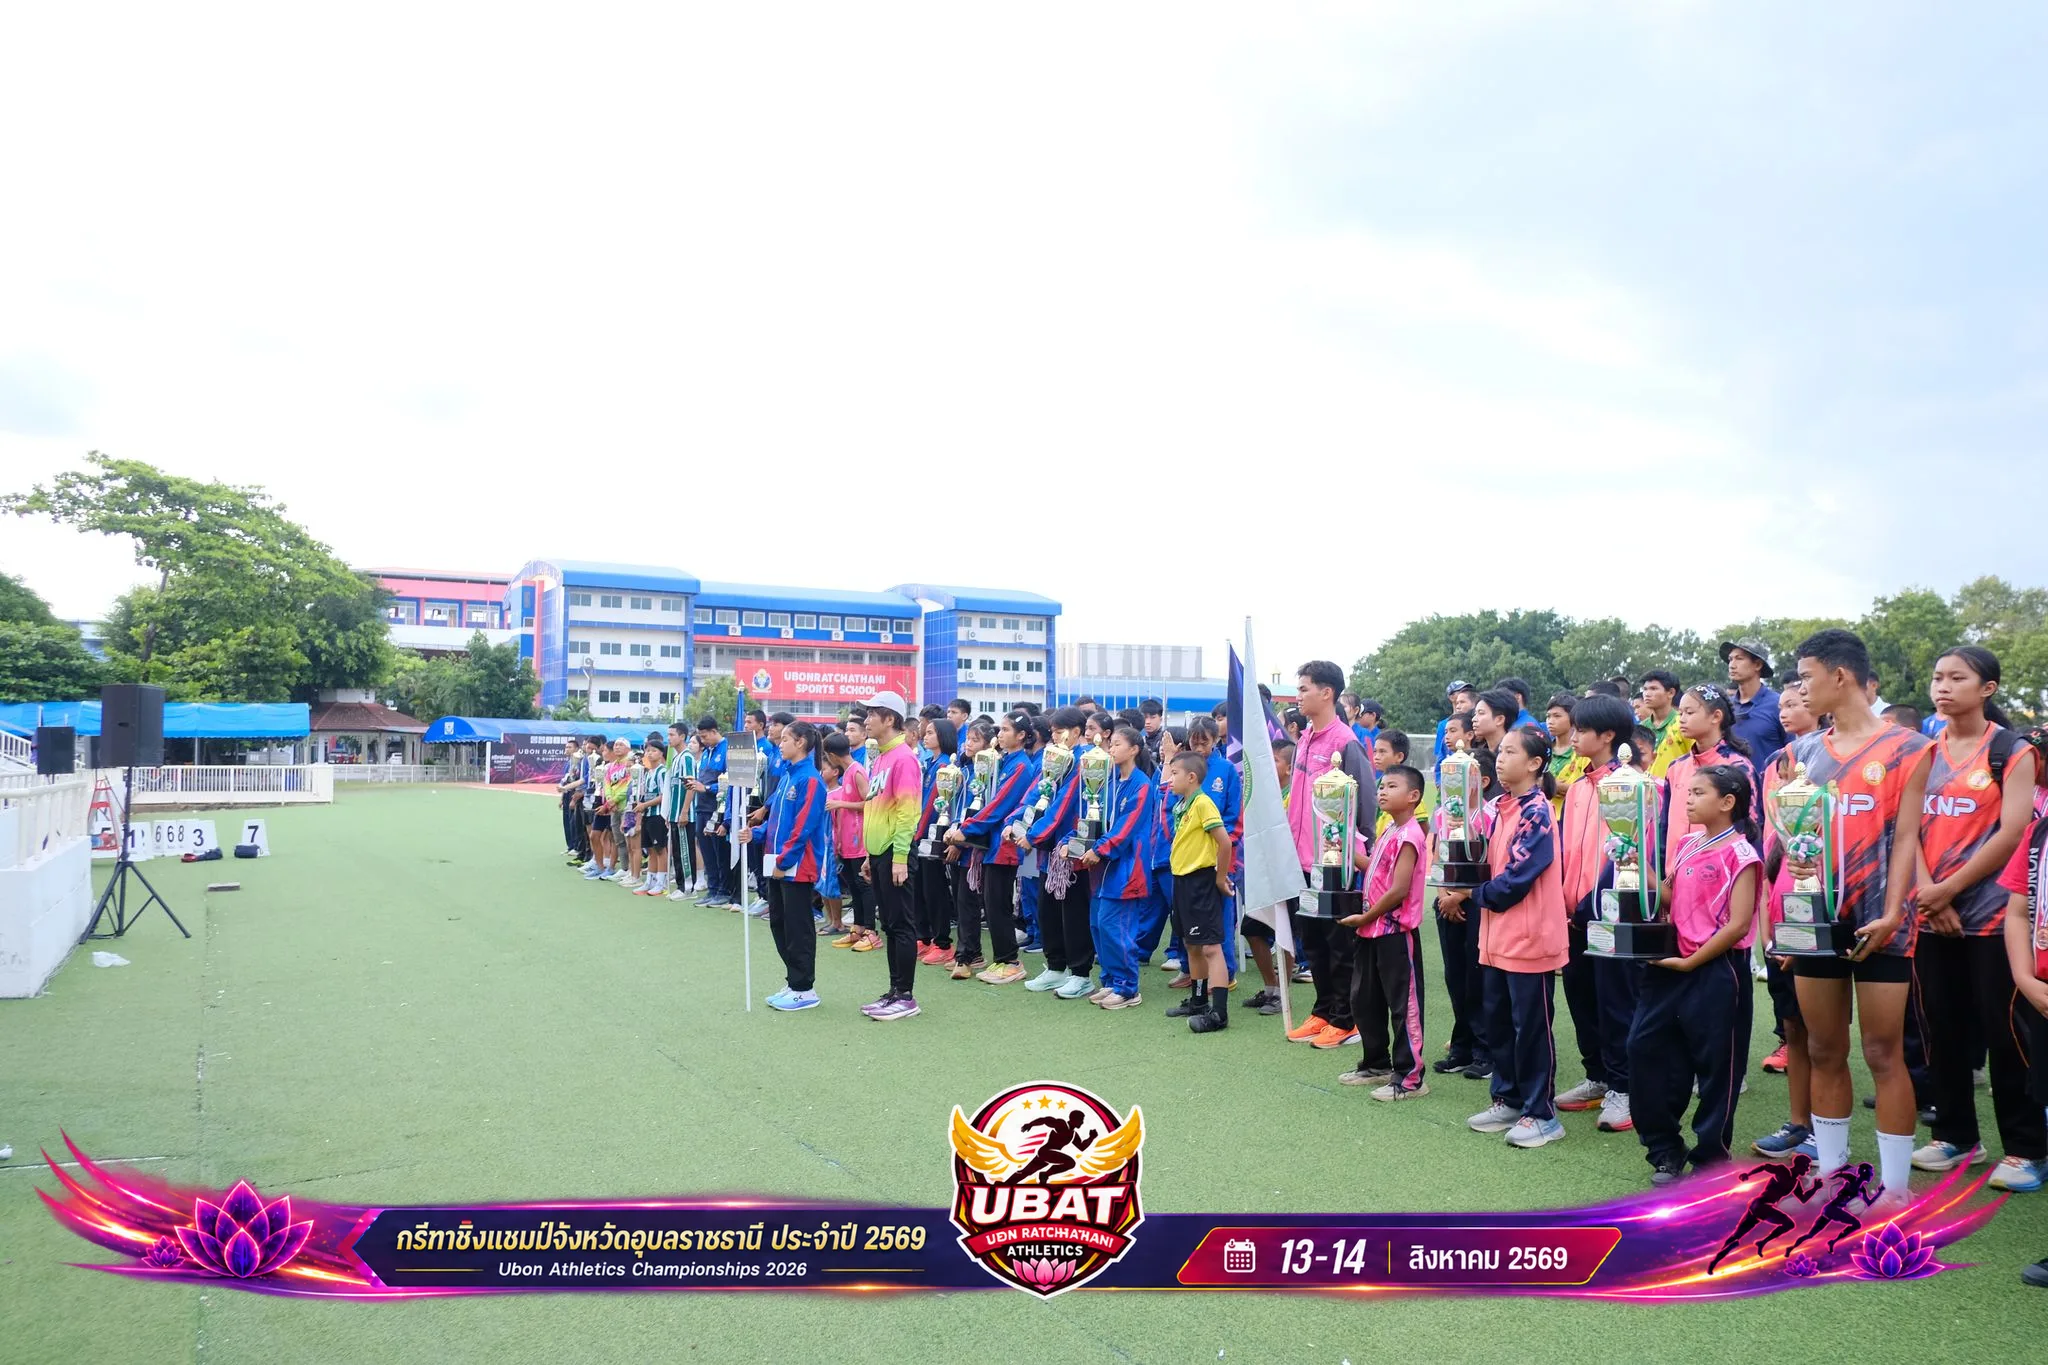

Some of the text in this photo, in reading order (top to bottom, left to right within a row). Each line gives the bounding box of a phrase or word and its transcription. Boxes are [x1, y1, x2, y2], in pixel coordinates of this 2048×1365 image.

[784, 671, 886, 685] UBONRATCHATHANI
[795, 684, 877, 696] SPORTS SCHOOL
[1923, 794, 1977, 817] KNP
[155, 825, 162, 843] 6
[167, 825, 174, 843] 6
[177, 825, 184, 842] 8
[193, 828, 205, 847] 3
[247, 825, 259, 844] 7
